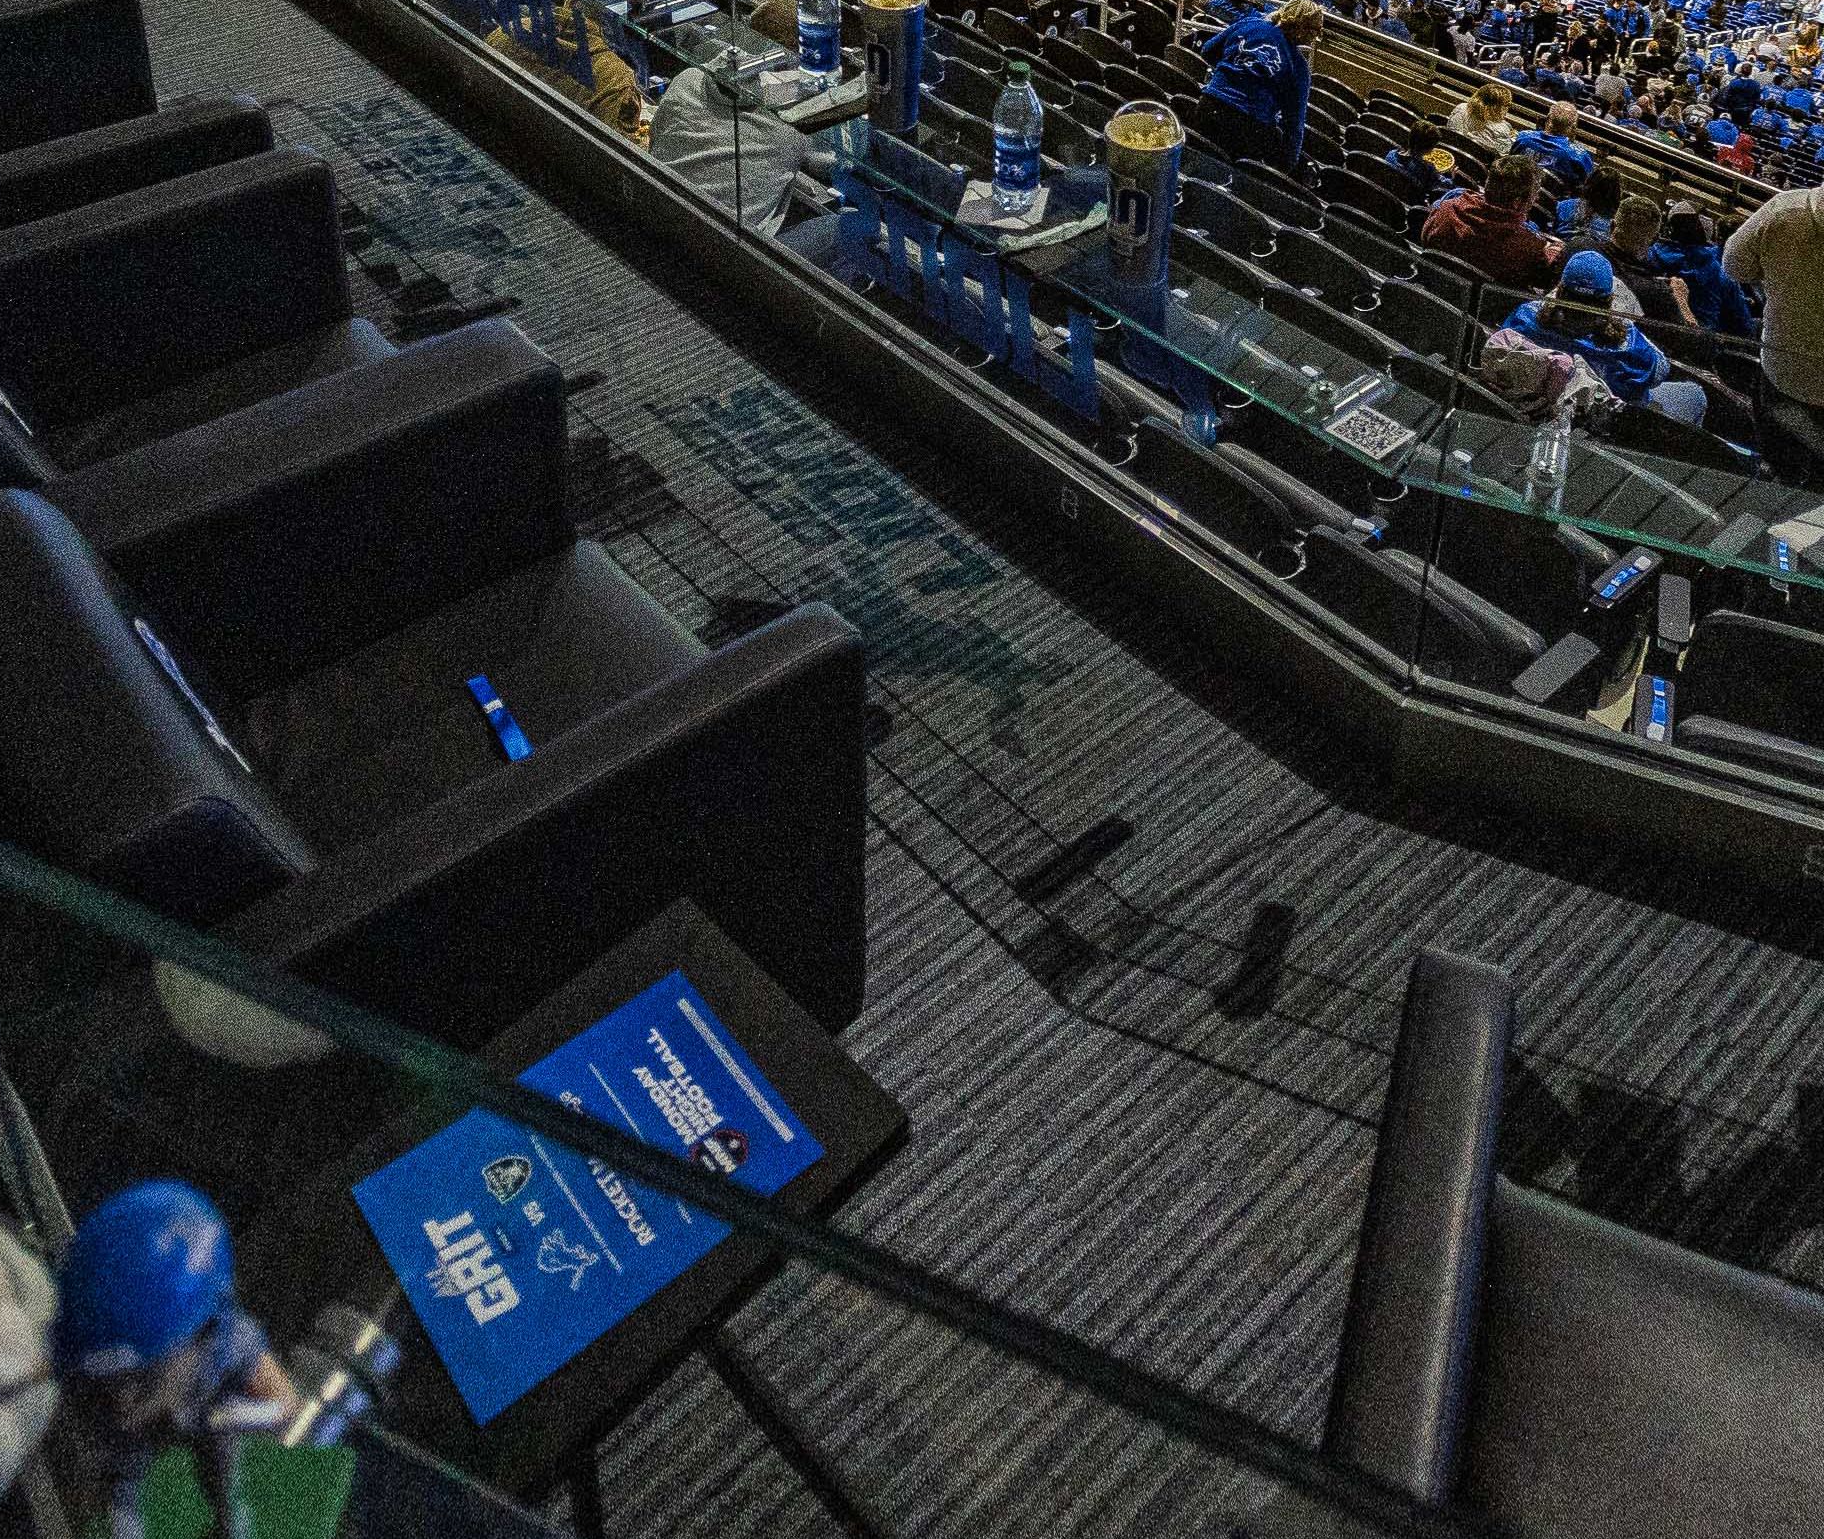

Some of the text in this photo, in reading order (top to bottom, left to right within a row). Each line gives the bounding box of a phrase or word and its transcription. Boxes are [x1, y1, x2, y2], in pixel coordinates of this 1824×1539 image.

[632, 1066, 698, 1145] MONDAY
[646, 1027, 725, 1126] FOOTBALL
[660, 1079, 709, 1136] NIGHT
[423, 1209, 521, 1326] GRIT
